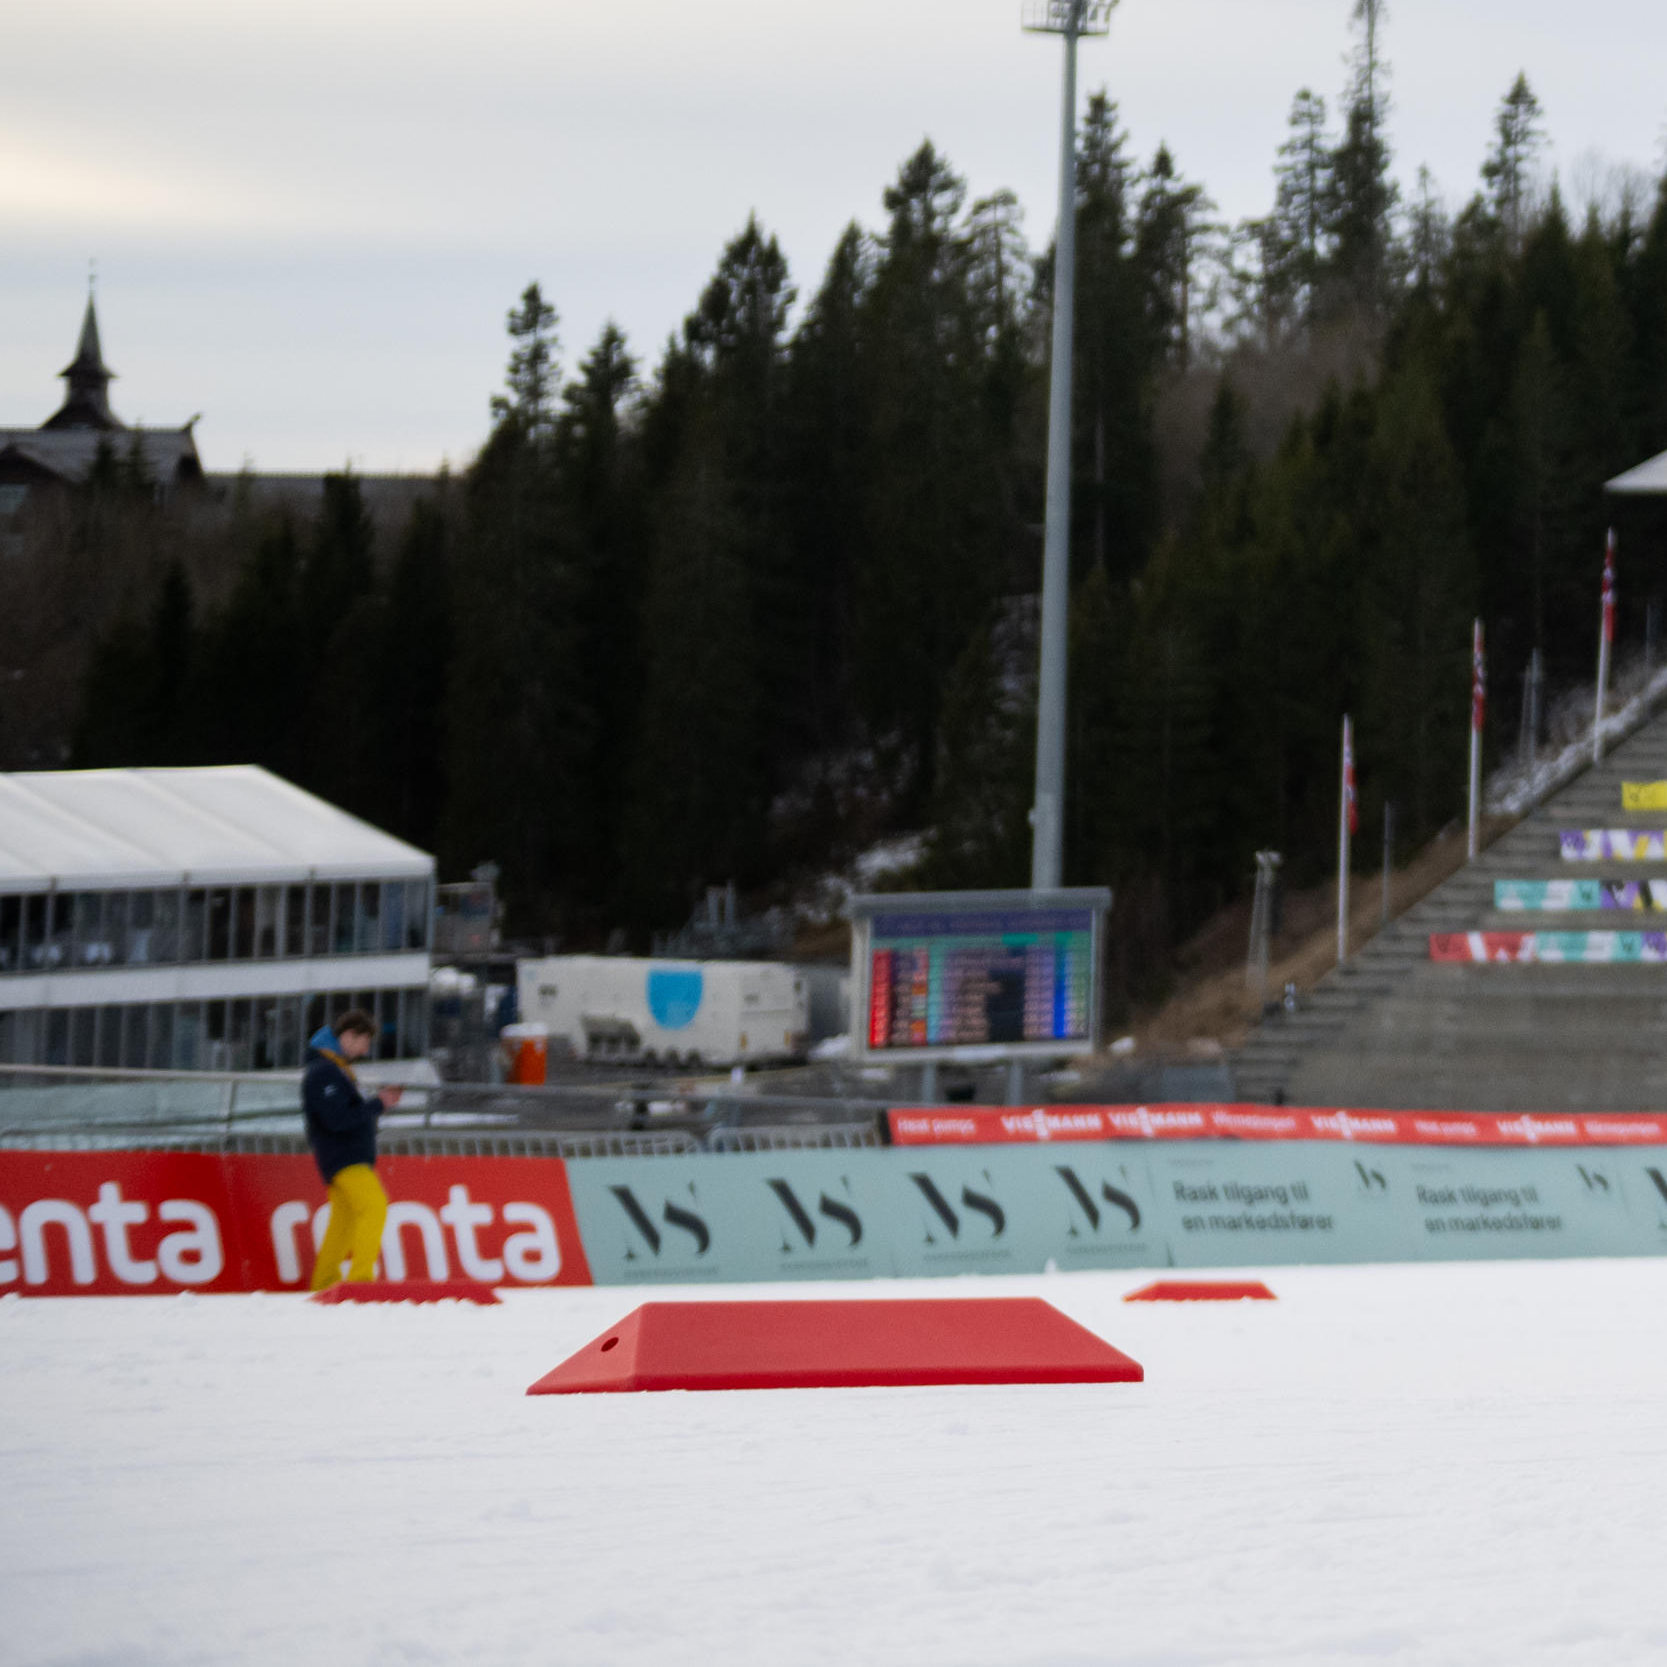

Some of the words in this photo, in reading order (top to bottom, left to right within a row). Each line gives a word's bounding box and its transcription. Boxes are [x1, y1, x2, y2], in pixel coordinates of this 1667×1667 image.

[1173, 1181, 1219, 1202] Rask
[1222, 1182, 1289, 1206] tilgang
[1290, 1181, 1309, 1201] til
[1182, 1215, 1204, 1232] en
